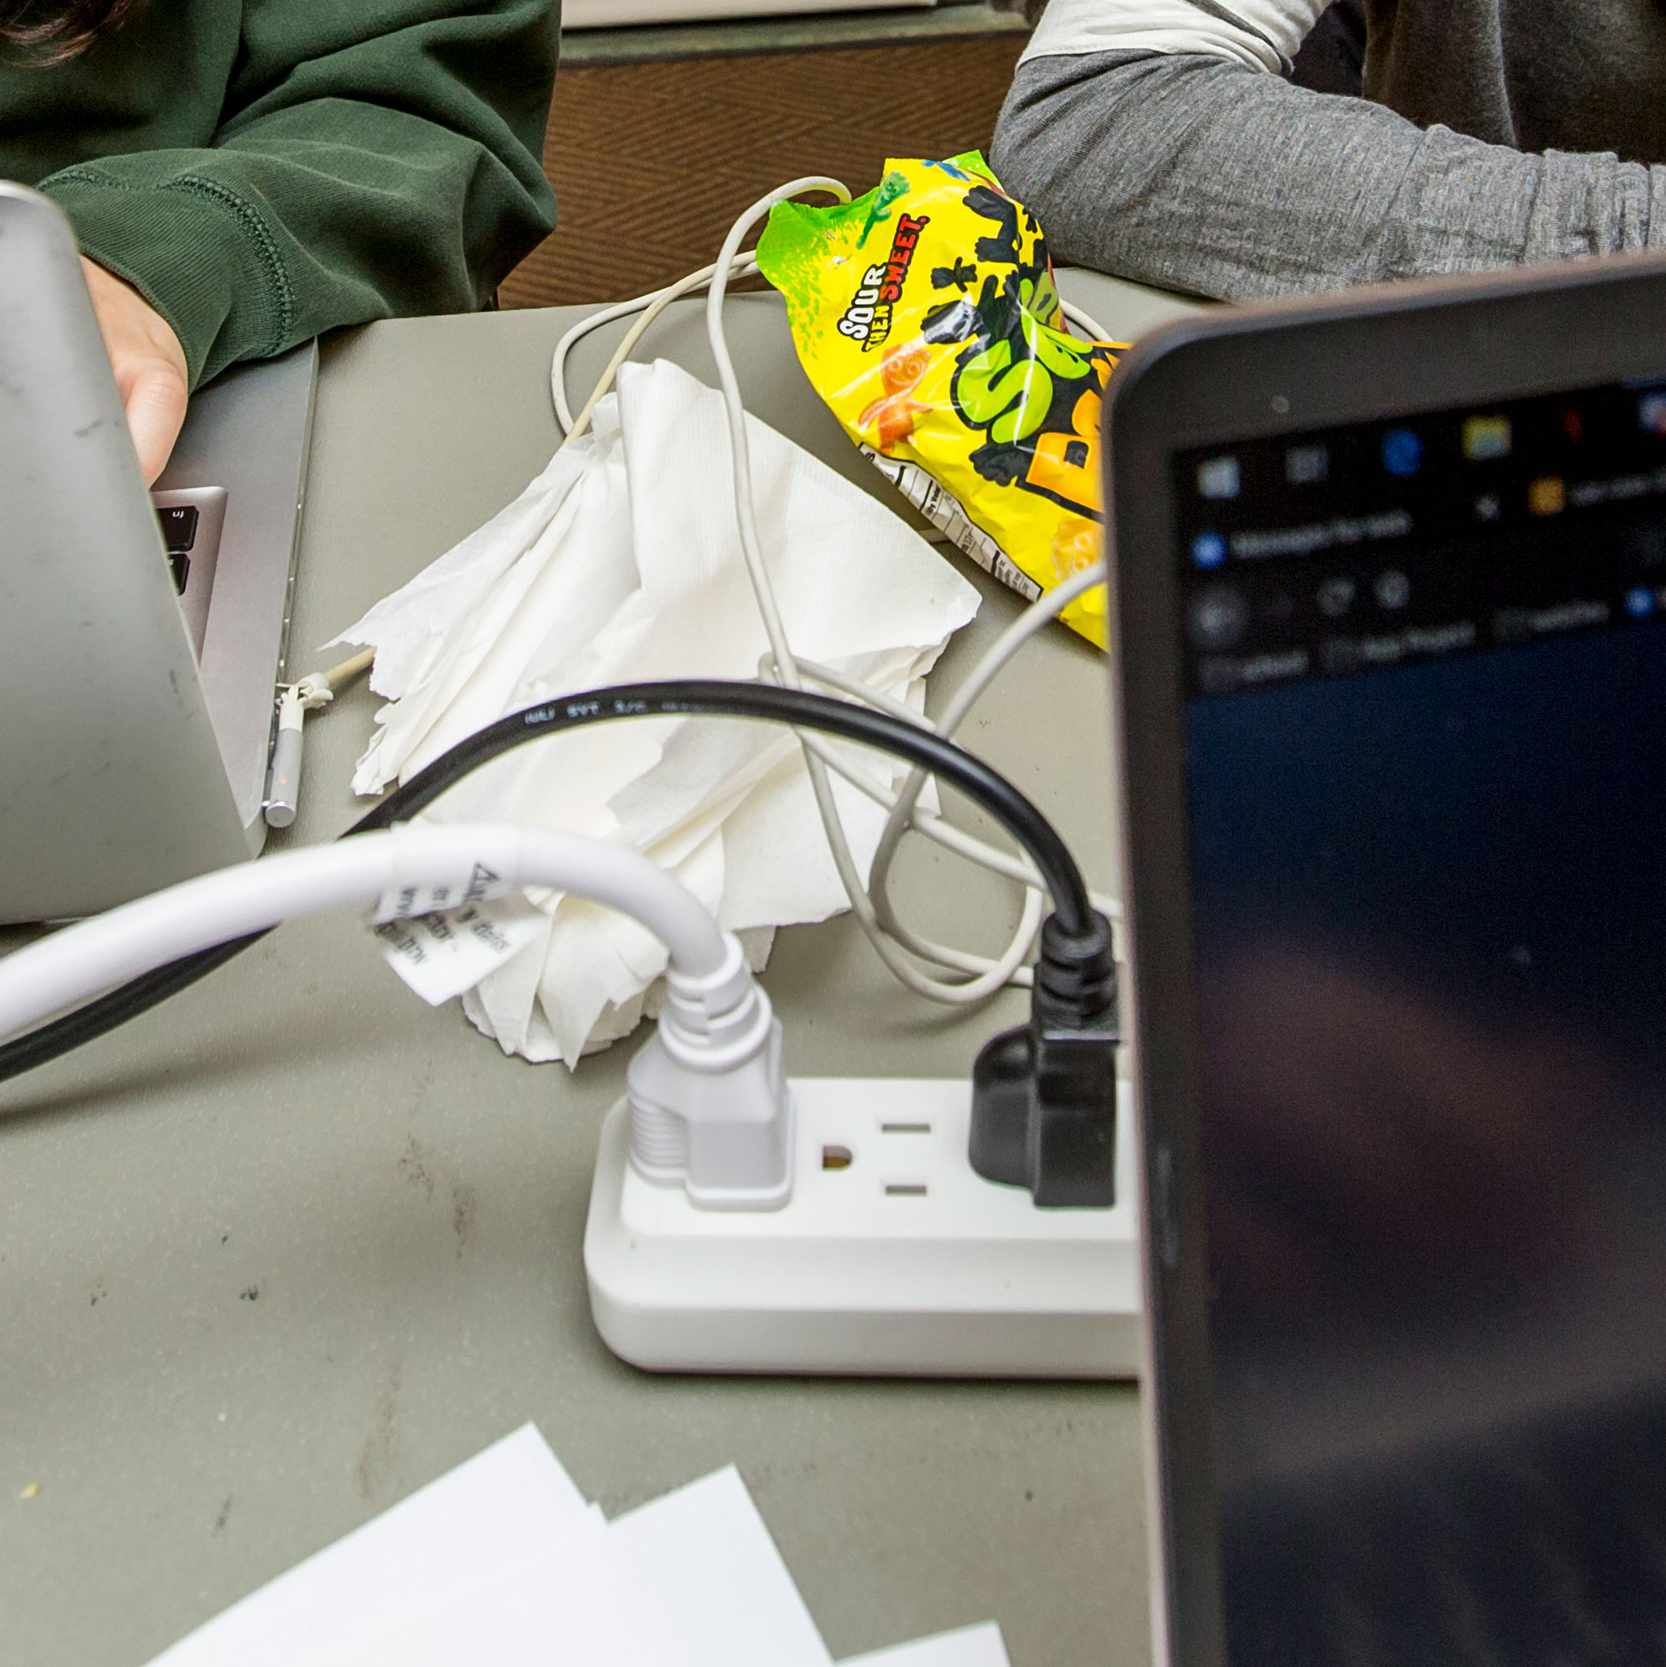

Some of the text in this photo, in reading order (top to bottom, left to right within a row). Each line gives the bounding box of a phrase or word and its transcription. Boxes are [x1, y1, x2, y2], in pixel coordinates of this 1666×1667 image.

[838, 263, 887, 341] SOUR
[862, 304, 891, 352] THEN
[172, 510, 185, 519] fn
